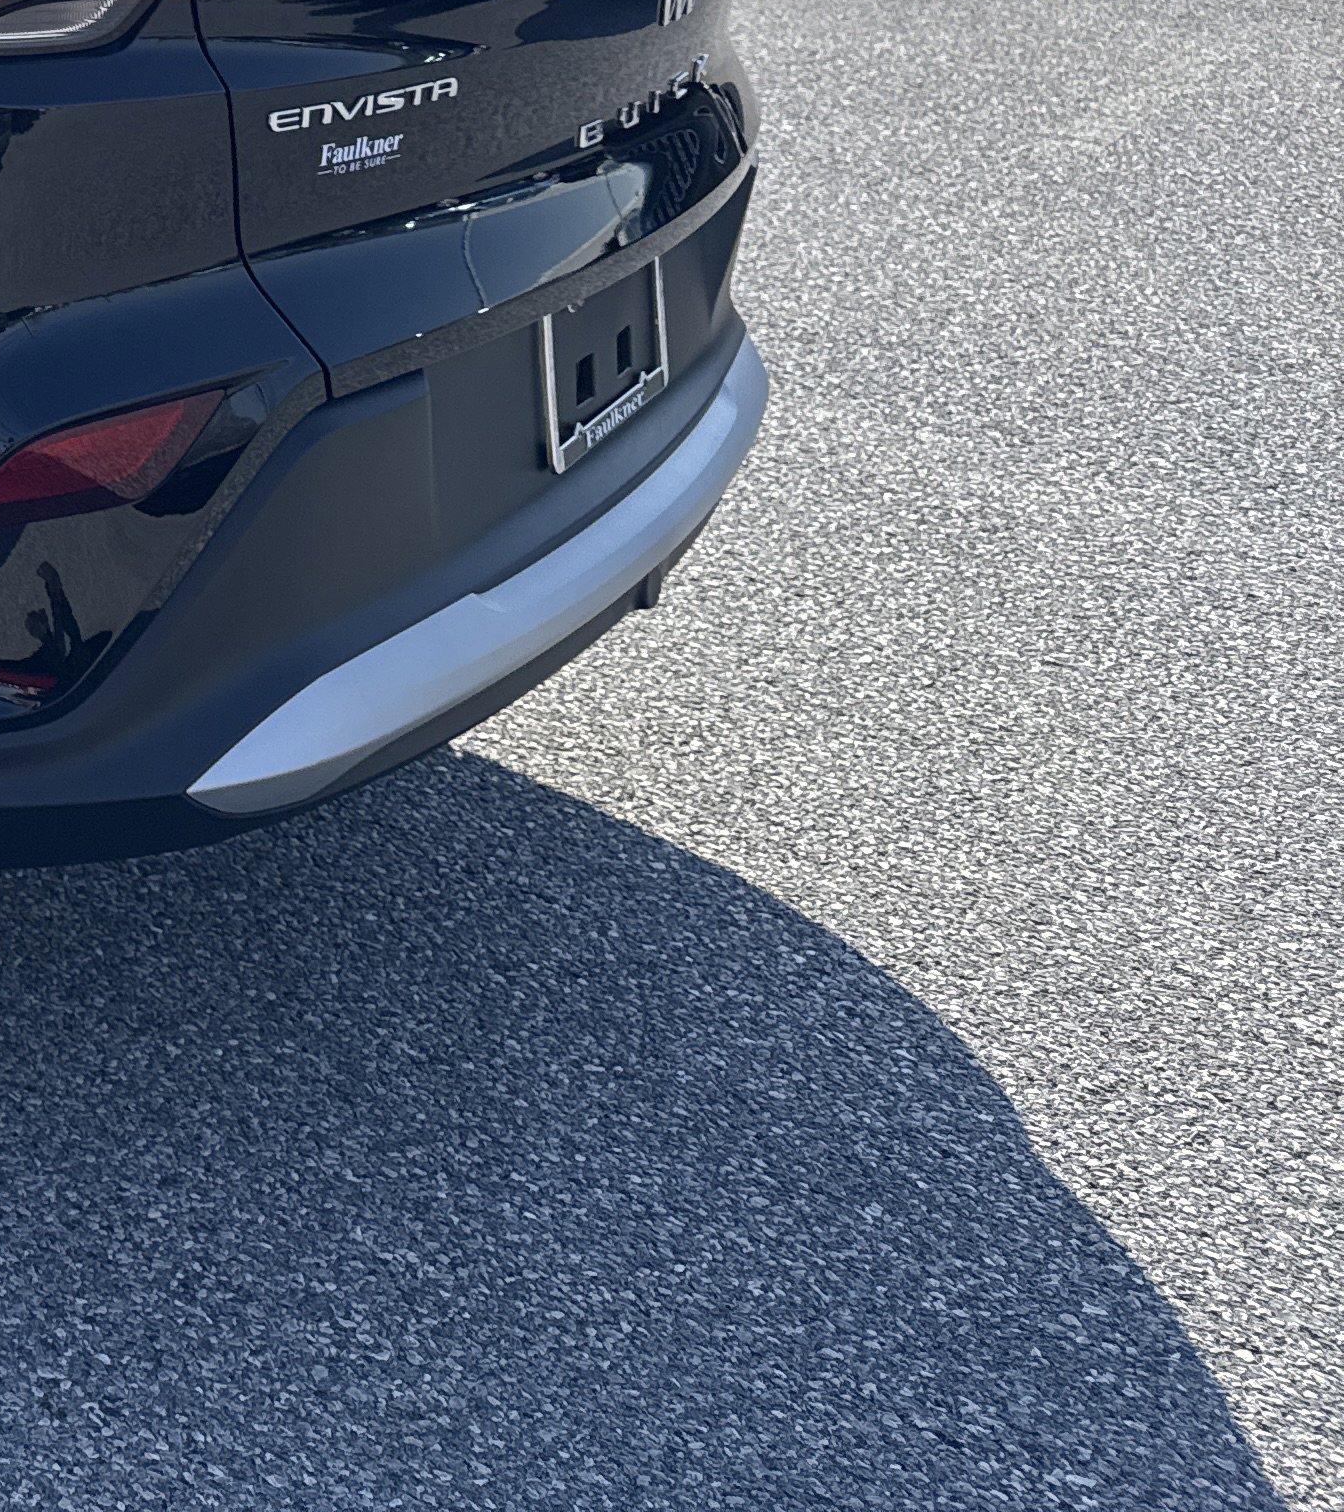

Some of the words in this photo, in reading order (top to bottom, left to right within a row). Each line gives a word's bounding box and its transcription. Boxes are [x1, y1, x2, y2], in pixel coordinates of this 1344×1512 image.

[268, 77, 459, 133] ENVISTA
[576, 53, 709, 149] BUICK
[319, 134, 405, 167] Faulkner
[333, 164, 347, 175] TO
[349, 160, 363, 172] BE
[363, 155, 386, 169] SURE
[584, 391, 645, 448] Faulkner
